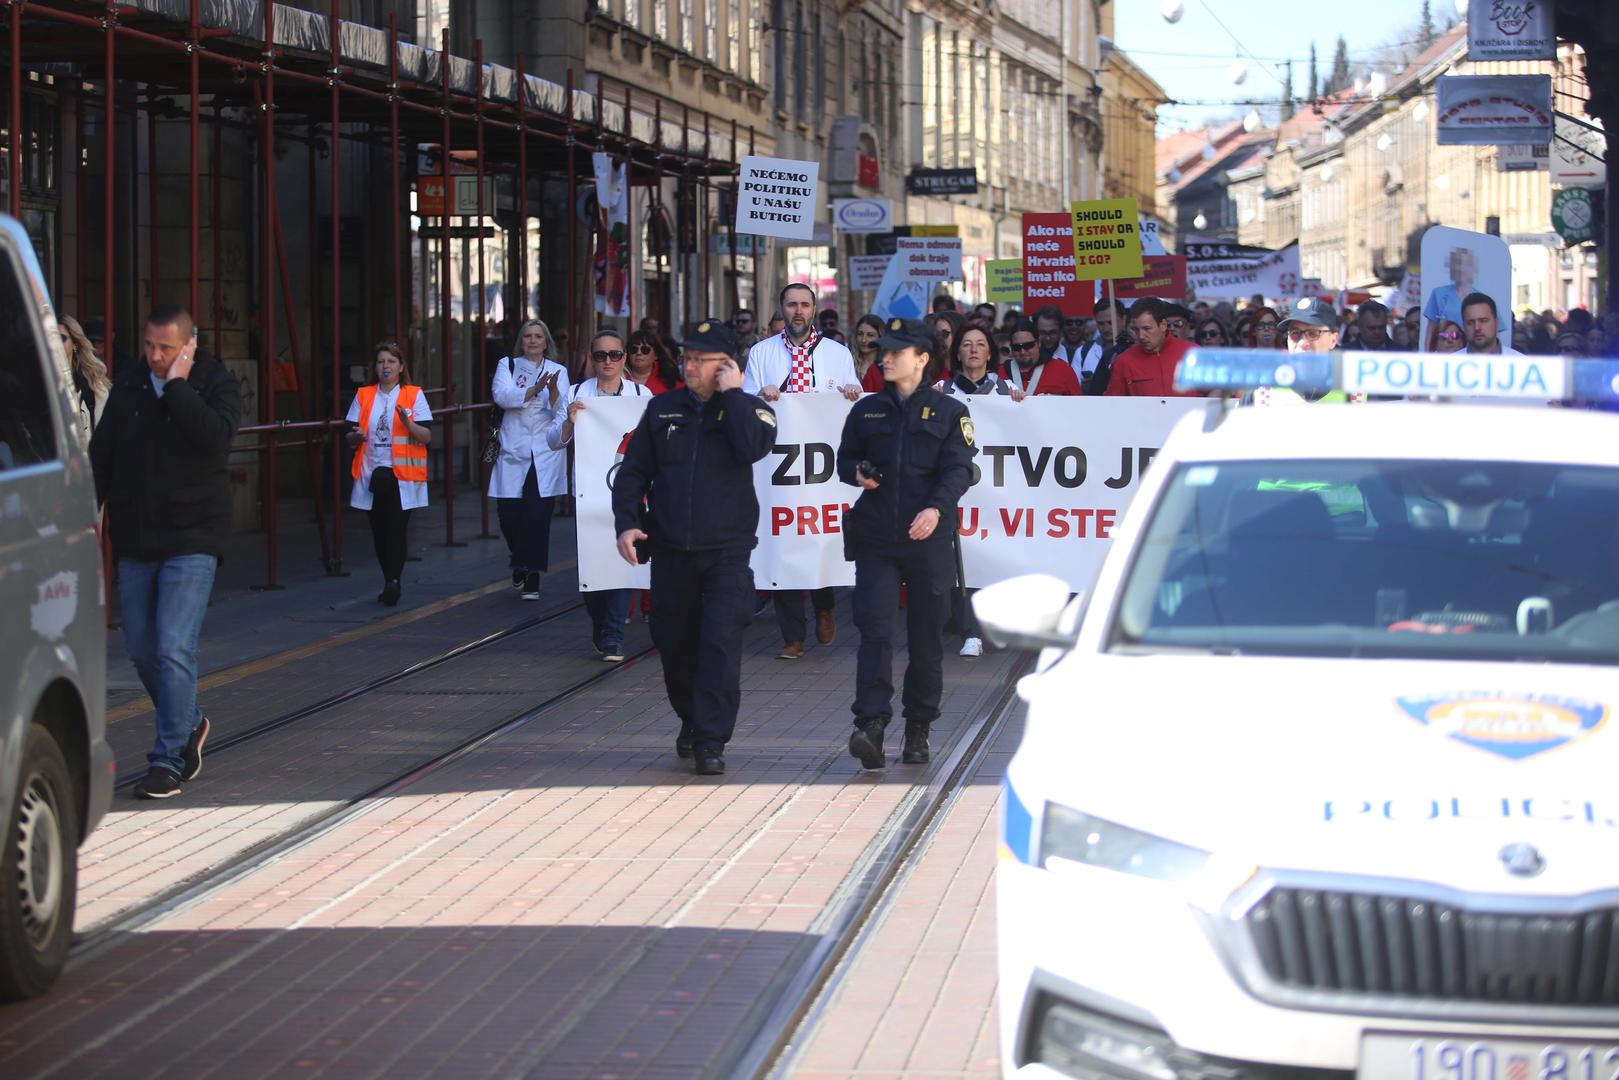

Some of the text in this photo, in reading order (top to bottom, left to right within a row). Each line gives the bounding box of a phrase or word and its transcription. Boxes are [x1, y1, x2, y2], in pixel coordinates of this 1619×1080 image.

[1489, 0, 1535, 21] Book
[750, 168, 809, 183] NEĆEMO
[744, 182, 812, 197] POLITIKU
[752, 197, 802, 210] U NAŠU
[750, 210, 802, 224] BUTIGU
[1076, 209, 1122, 221] SHOULD
[1027, 225, 1054, 236] Ako
[1077, 223, 1134, 236] I STAY OR
[899, 240, 961, 249] Nema odmora
[1027, 240, 1060, 251] neće
[1078, 238, 1125, 251] SHOULD
[909, 254, 950, 264] dok traje
[1080, 254, 1111, 265] I GO?
[909, 267, 949, 276] obmana!
[1027, 271, 1052, 282] ima
[1053, 271, 1076, 282] tko
[1027, 286, 1065, 297] hoće!
[1356, 357, 1546, 391] POLICIJA
[1000, 508, 1034, 538] VI
[1046, 508, 1117, 539] STE
